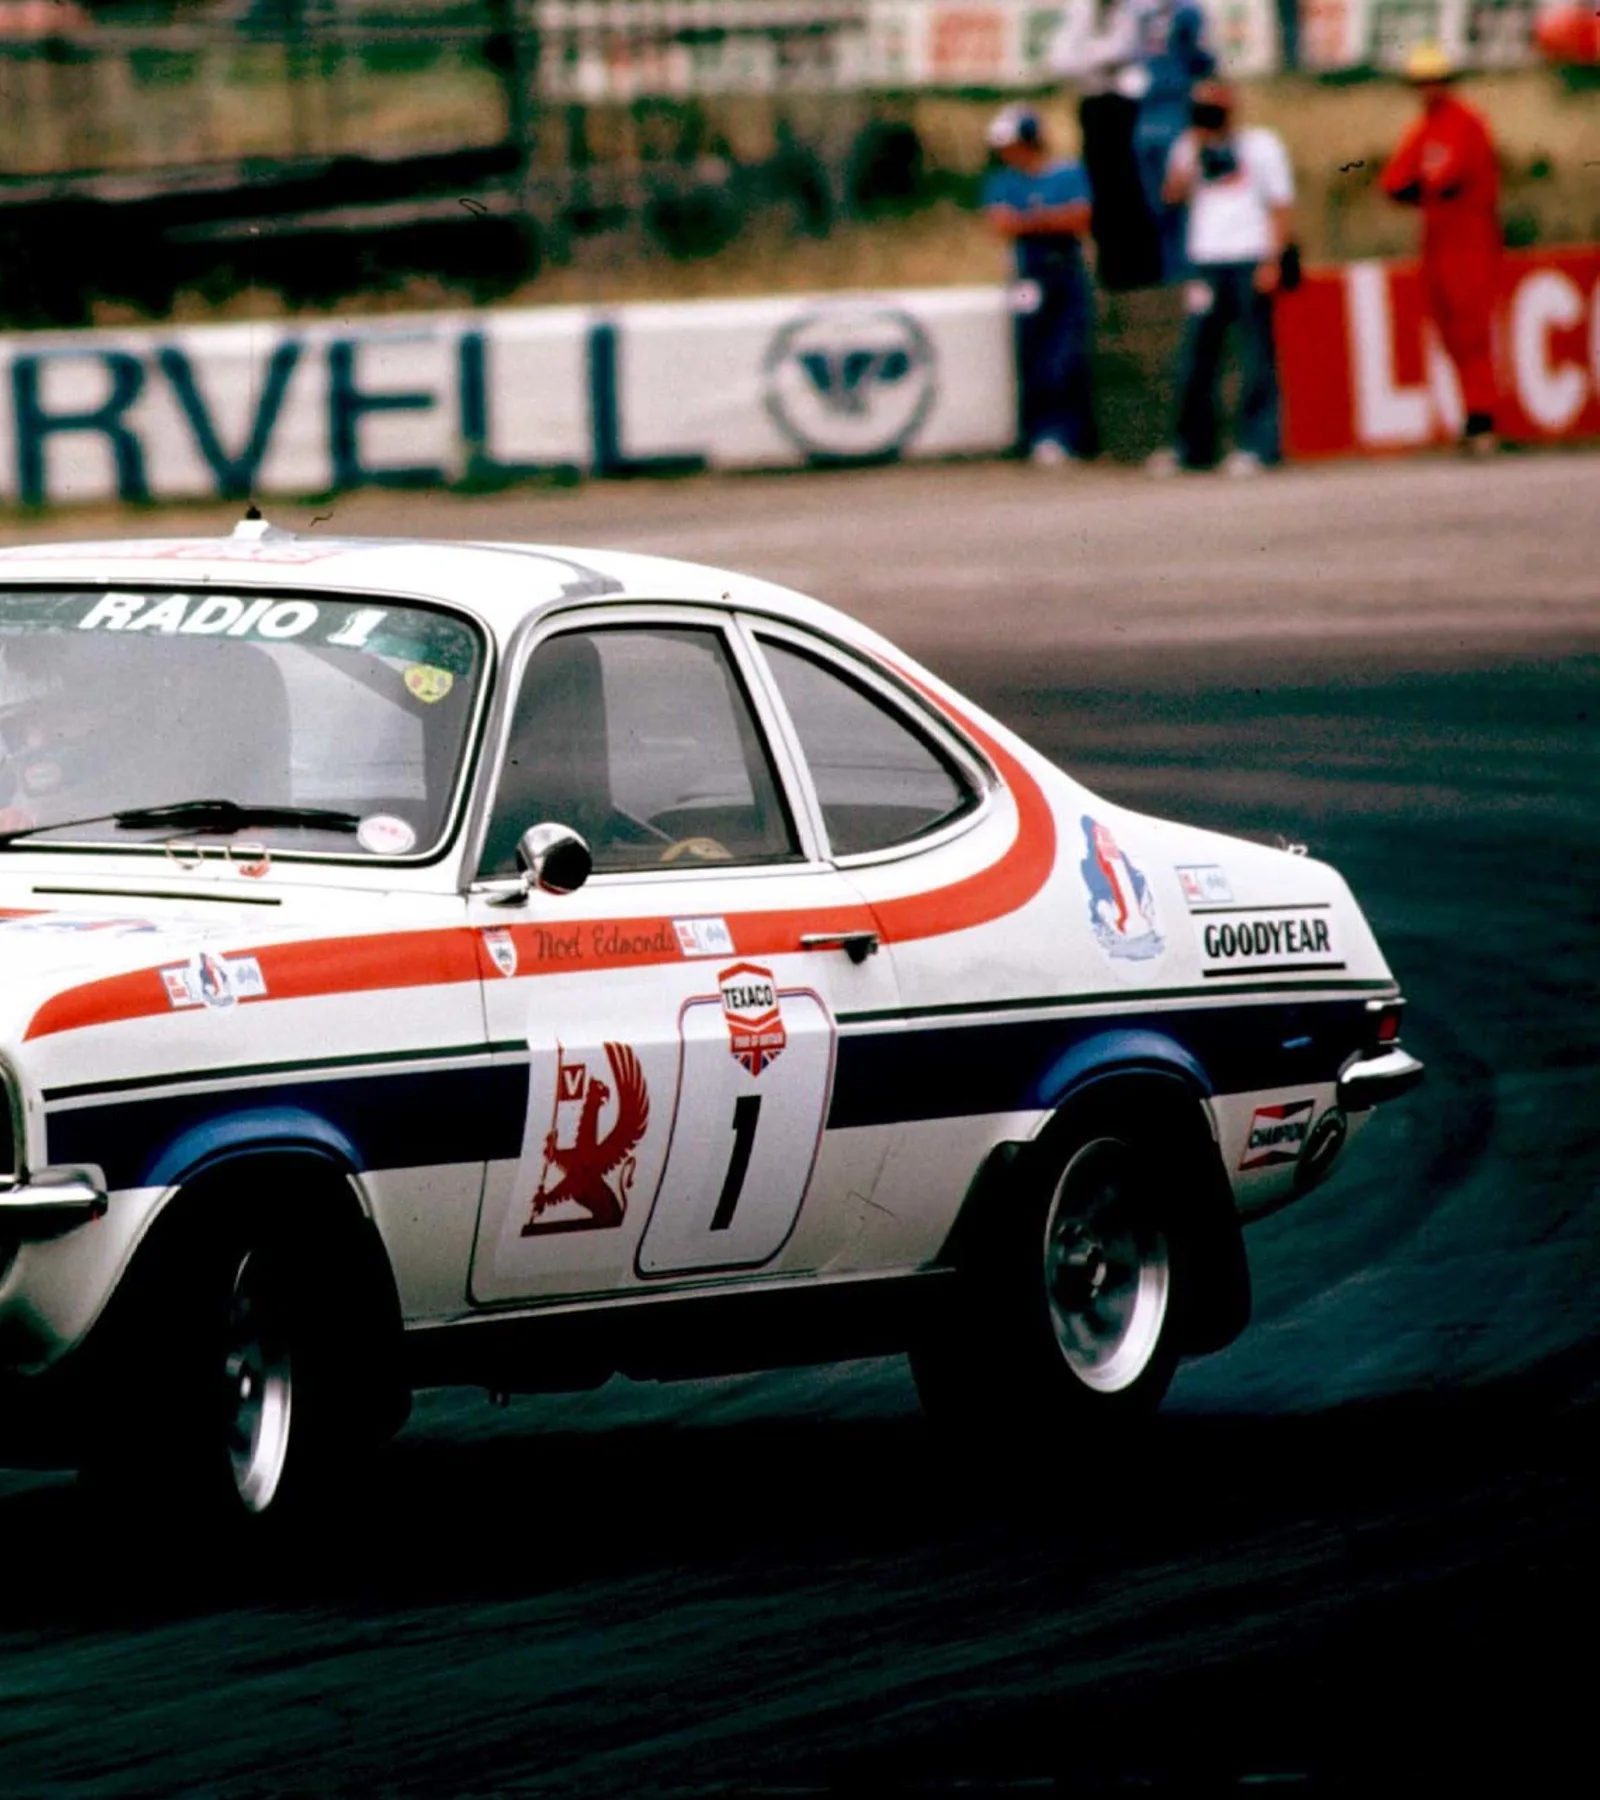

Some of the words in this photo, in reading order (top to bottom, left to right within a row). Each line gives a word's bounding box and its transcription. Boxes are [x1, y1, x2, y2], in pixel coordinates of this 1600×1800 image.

[78, 593, 320, 638] RADIO
[327, 609, 386, 646] 1
[1205, 919, 1331, 958] GOODYEAR
[722, 984, 774, 1009] TEXACO
[563, 1068, 583, 1096] V
[1248, 1122, 1308, 1150] CHAMPION
[709, 1094, 763, 1230] 1
